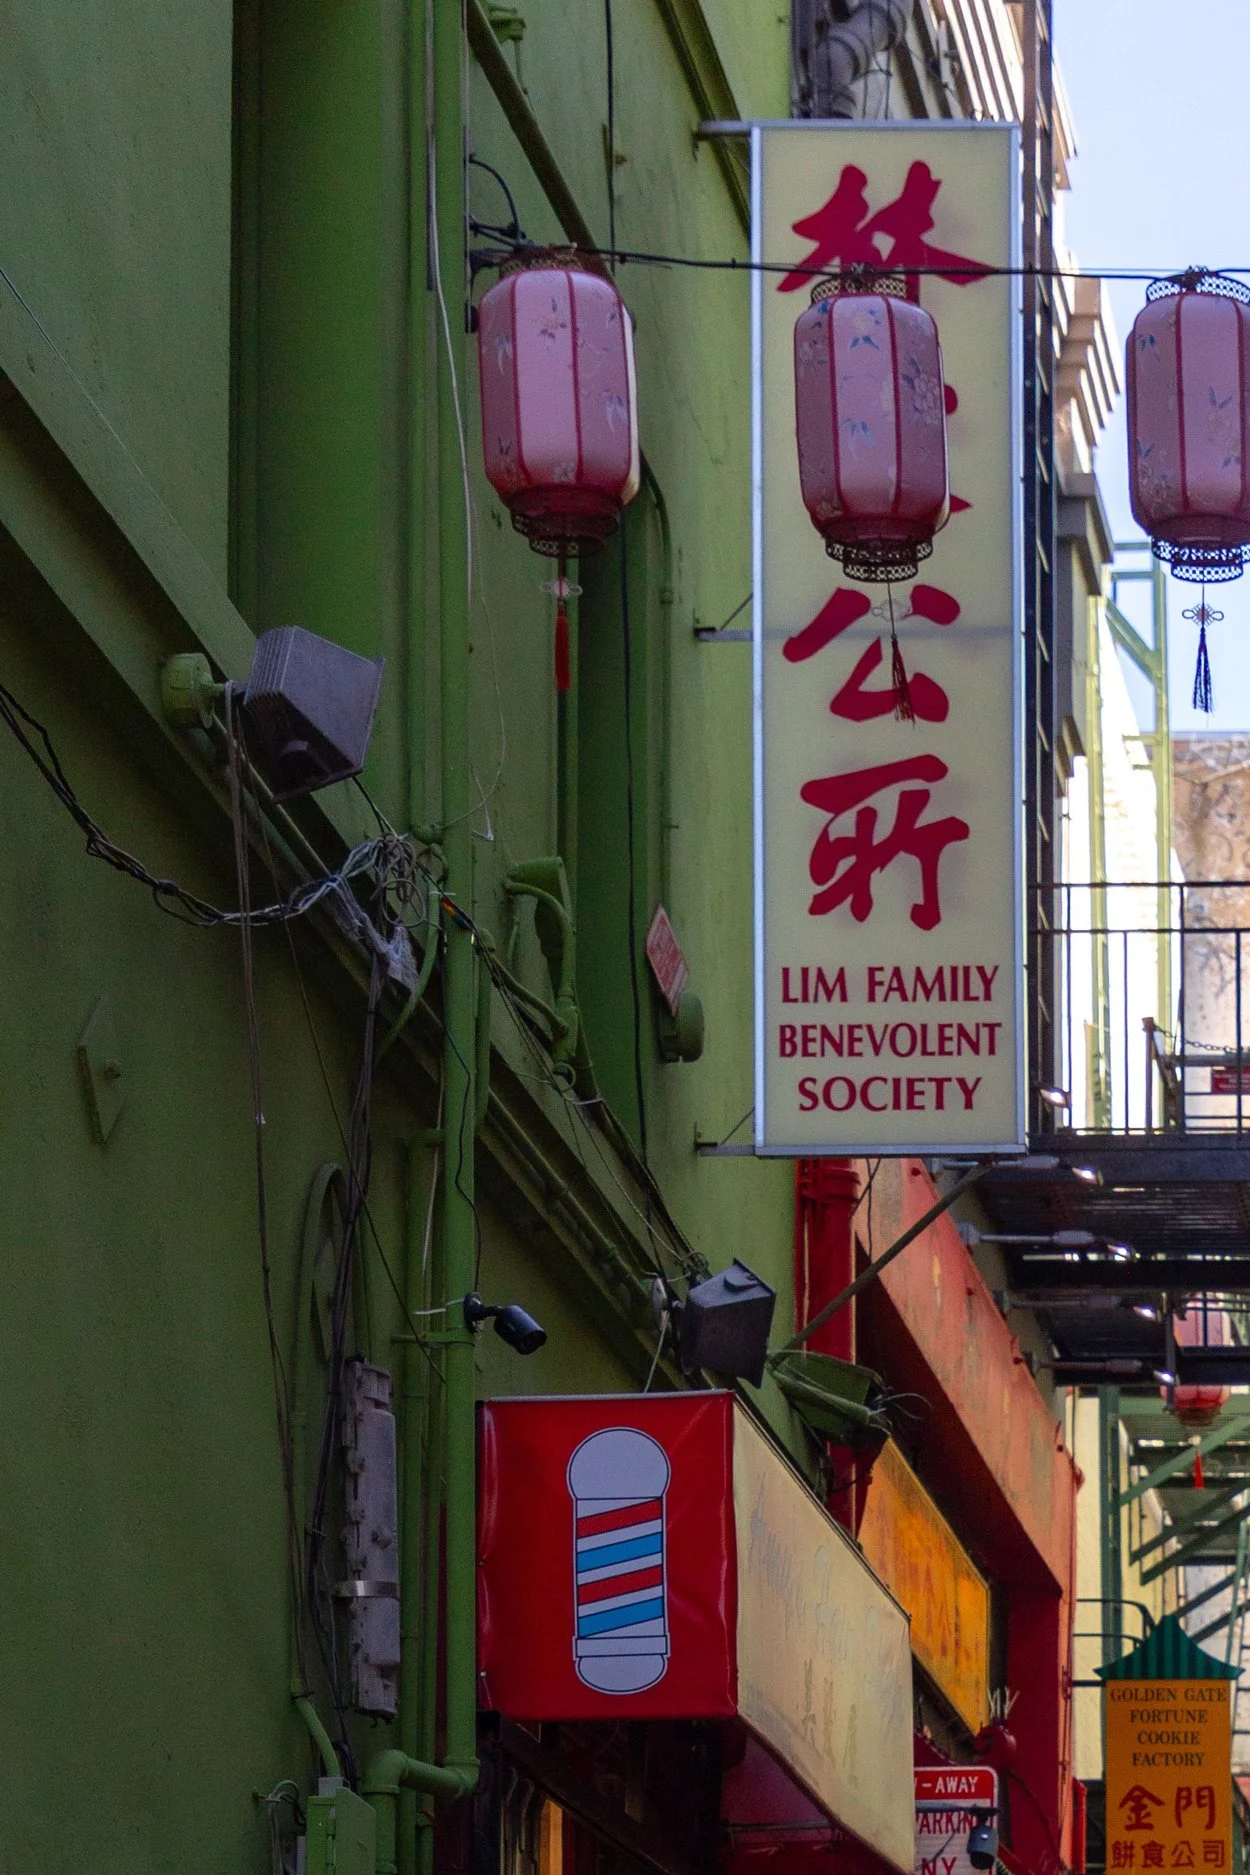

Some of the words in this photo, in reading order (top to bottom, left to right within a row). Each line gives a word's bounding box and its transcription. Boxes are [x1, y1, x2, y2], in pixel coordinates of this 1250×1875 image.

[777, 159, 997, 931] 林公所
[781, 966, 848, 1004] LIM
[866, 965, 999, 1003] FAMILY
[778, 1022, 1003, 1058] BENEVOLENT
[798, 1076, 983, 1112] SOCIETY
[1110, 1688, 1178, 1702] GOLDEN
[1184, 1688, 1227, 1701] GATE
[1130, 1709, 1208, 1724] FORTUNE
[1137, 1731, 1201, 1746] COOKIE
[1132, 1752, 1205, 1768] FACTORY
[1119, 1785, 1216, 1831] 金門
